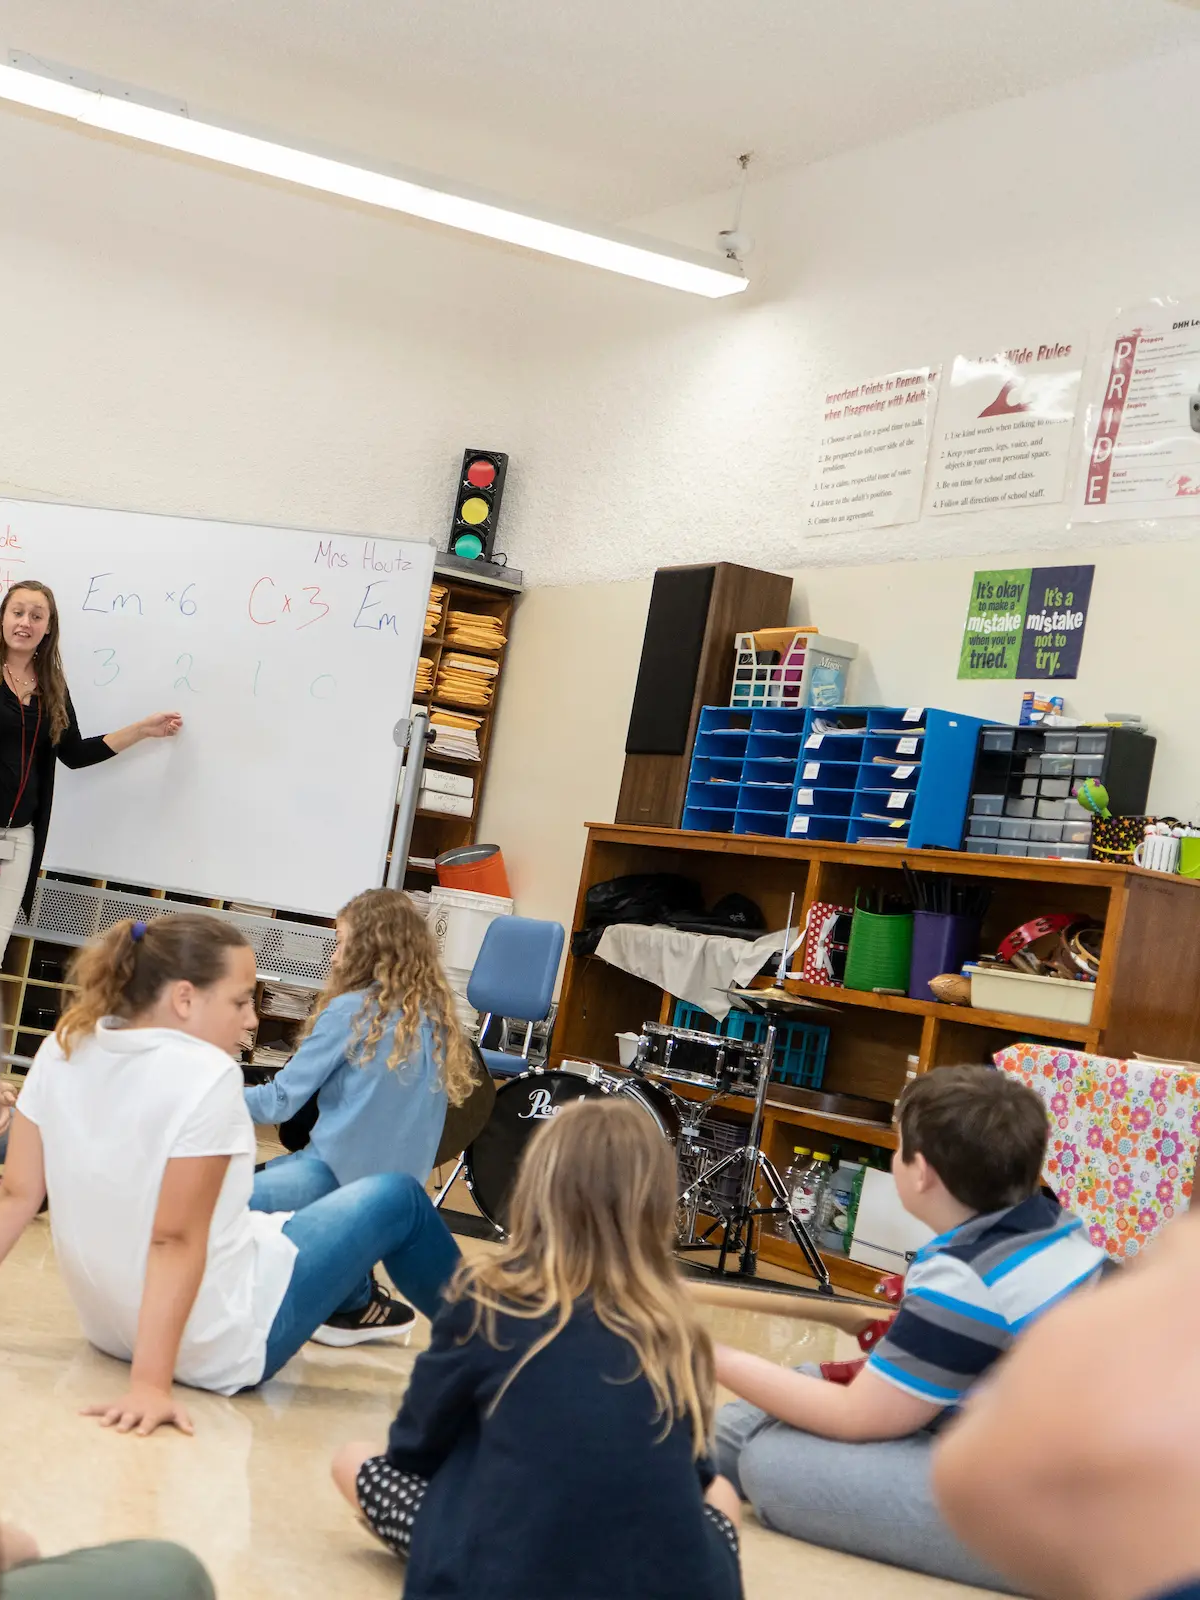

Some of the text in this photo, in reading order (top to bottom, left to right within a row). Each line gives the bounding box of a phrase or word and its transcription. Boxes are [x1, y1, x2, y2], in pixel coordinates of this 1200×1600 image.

[1172, 320, 1189, 329] DHH
[1037, 343, 1072, 361] Rules
[825, 372, 937, 405] Important Points to Rememer
[843, 399, 886, 418] Disagreeing
[888, 393, 905, 409] with
[962, 429, 976, 438] kind
[977, 426, 994, 436] words
[996, 424, 1012, 433] when
[1013, 420, 1036, 431] talking
[947, 450, 962, 459] Keep
[1030, 437, 1043, 446] and
[945, 461, 966, 471] objects
[973, 458, 987, 468] your
[1002, 451, 1030, 463] personal
[943, 481, 950, 489] Be
[960, 478, 974, 487] time
[975, 476, 984, 485] for
[984, 474, 1004, 484] school
[1005, 472, 1017, 481] and
[940, 499, 960, 508] Follow
[960, 498, 969, 506] all
[970, 495, 999, 505] directions
[1000, 493, 1006, 501] of
[1007, 491, 1028, 501] school
[814, 517, 830, 525] Come
[314, 540, 414, 573] Mrs Houtz
[82, 573, 144, 616] Em
[977, 581, 1025, 602] It's okay
[1044, 588, 1074, 607] It's a
[353, 580, 399, 636] Em
[979, 599, 1015, 611] to make a
[968, 612, 1021, 634] mistake
[1026, 610, 1084, 632] mistake
[969, 633, 1016, 648] when you've
[1035, 633, 1066, 647] not to
[970, 647, 1007, 669] tried.
[1036, 650, 1060, 675] try.
[94, 648, 120, 687] 3
[174, 653, 198, 693] 2
[518, 1089, 586, 1119] Pea
